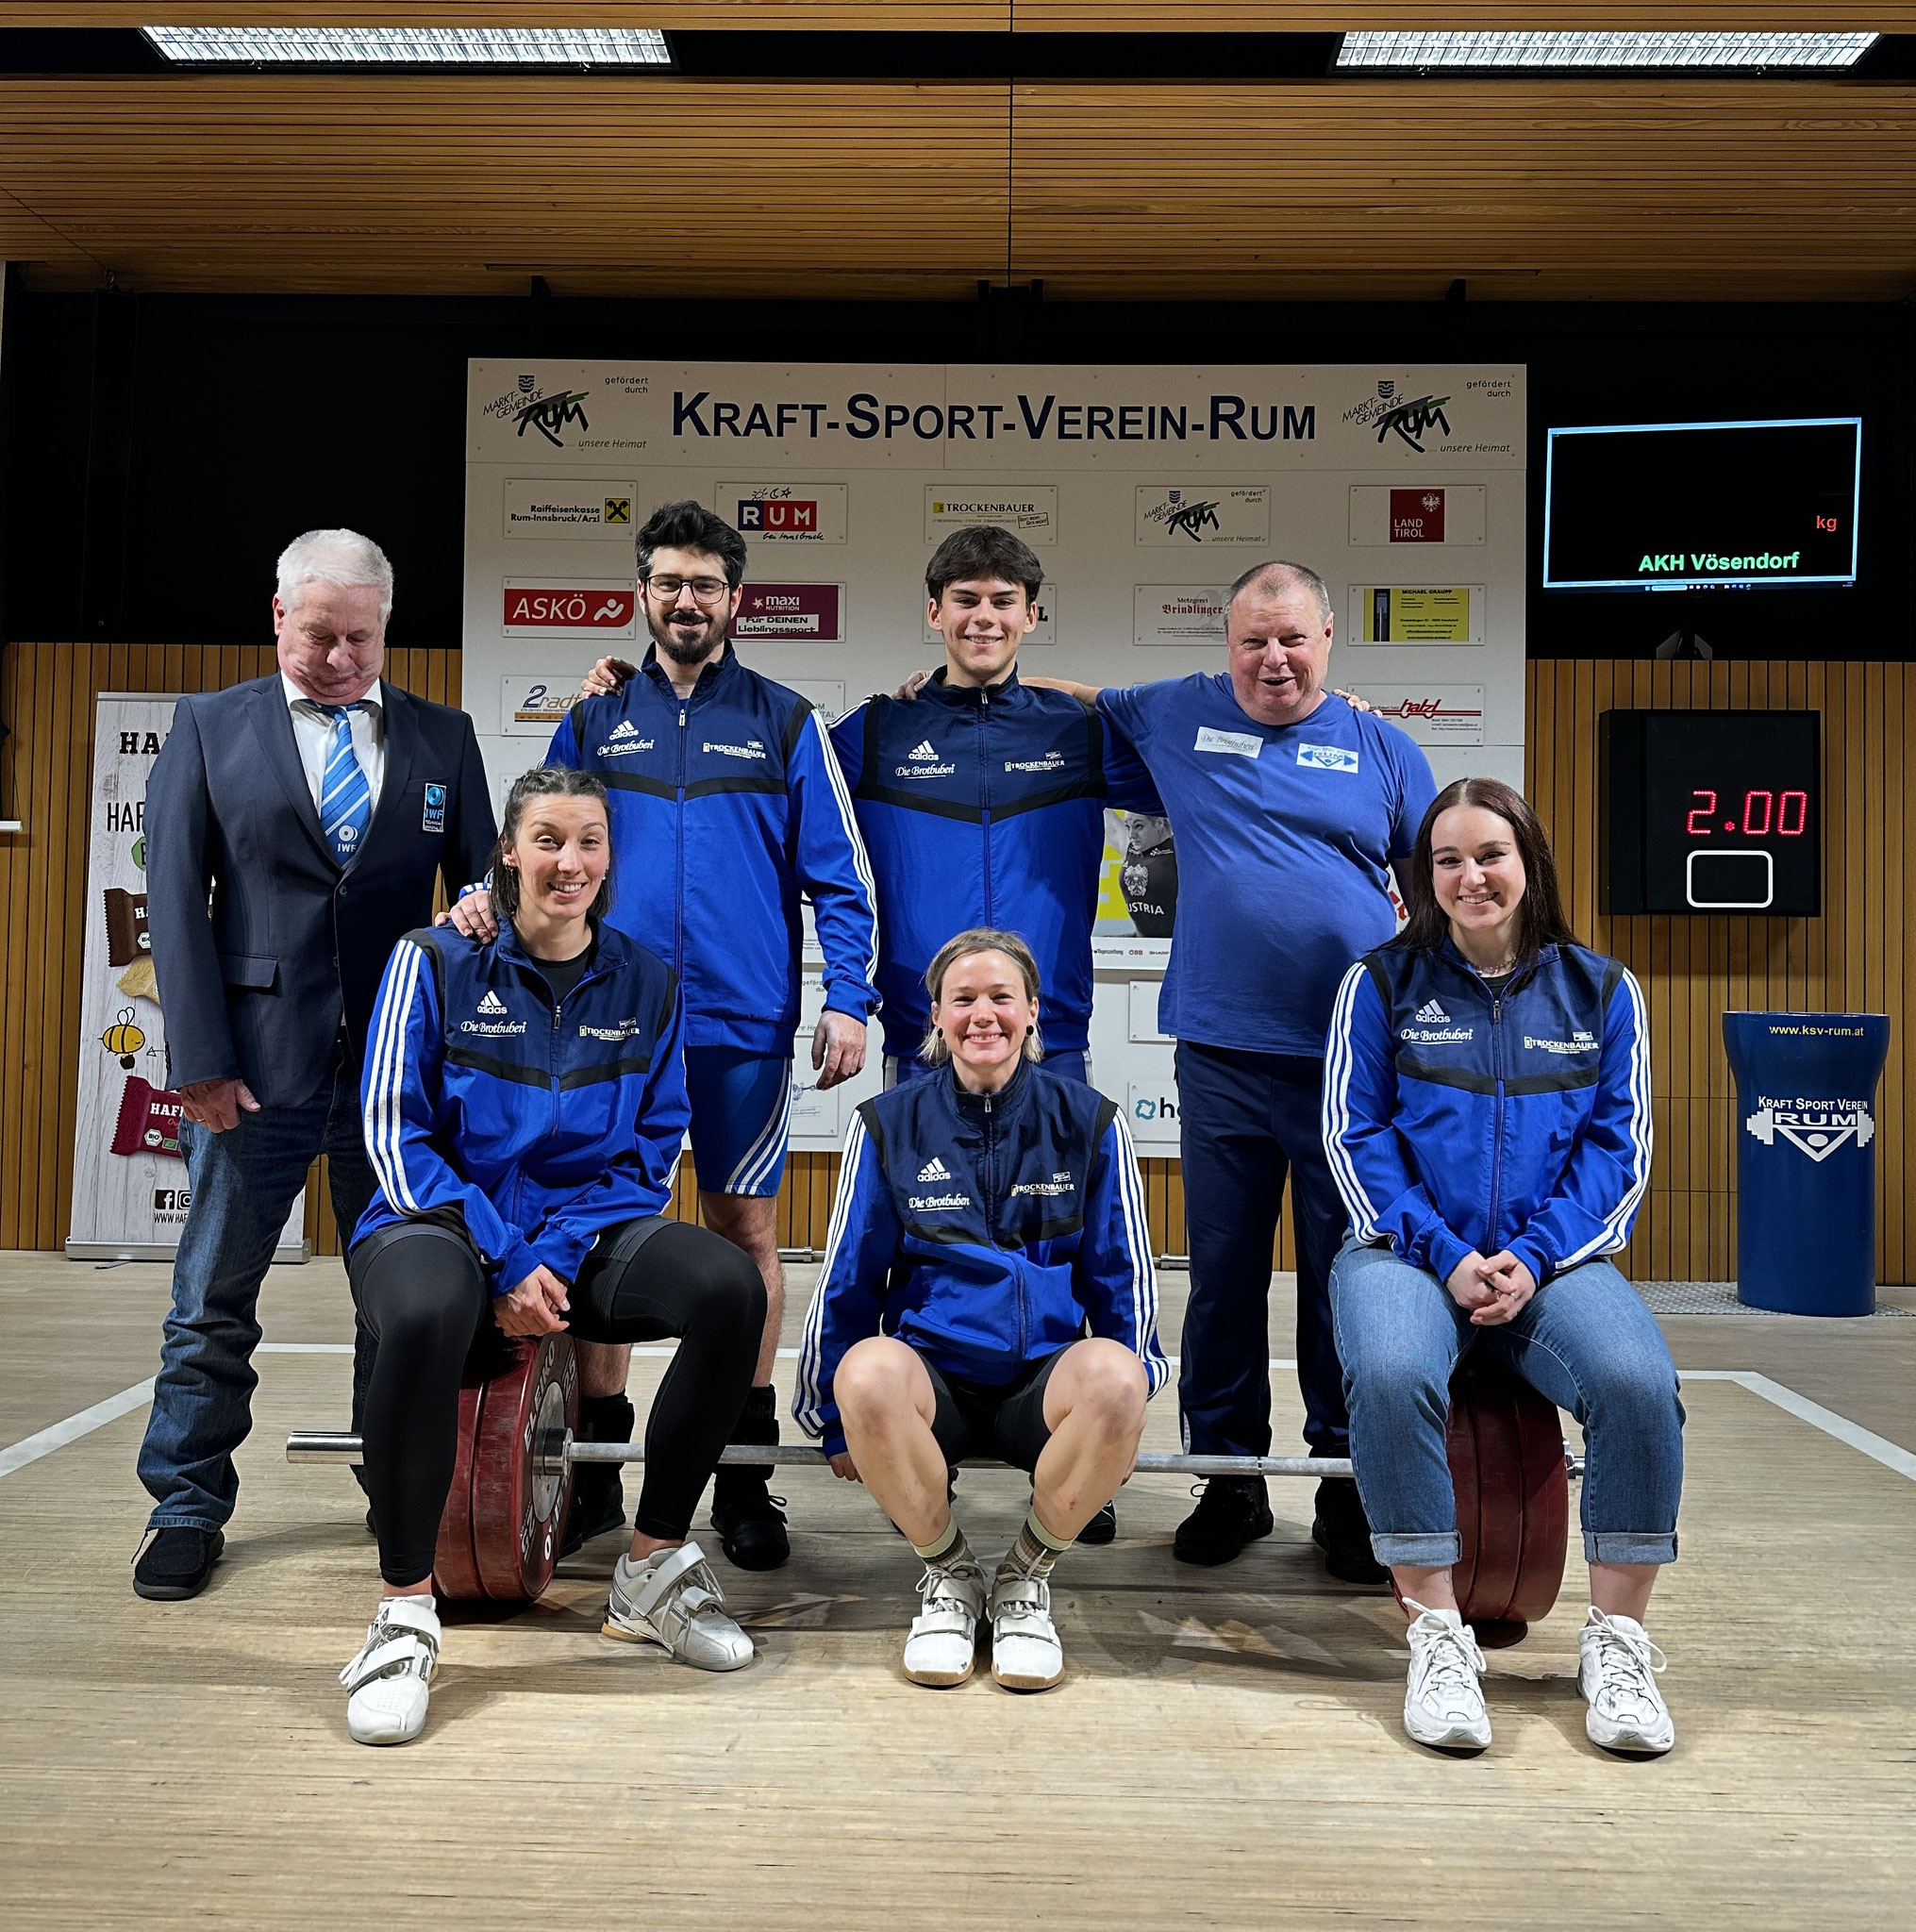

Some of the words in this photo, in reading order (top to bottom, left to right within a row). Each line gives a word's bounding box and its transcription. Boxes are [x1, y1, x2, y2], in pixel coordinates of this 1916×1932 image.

[605, 376, 648, 385] gefördert
[1466, 379, 1511, 389] gefördert
[483, 391, 519, 416] MARKT-
[496, 388, 543, 419] GEMEINDE
[1341, 396, 1378, 423] MARKT-
[1356, 393, 1404, 425] GEMEINDE
[518, 401, 590, 448] RUM
[1377, 405, 1451, 454] RUM
[578, 440, 610, 448] unsere
[612, 440, 647, 448] Heimat
[1441, 444, 1473, 453] unsere
[1474, 443, 1510, 453] Heimat
[530, 505, 600, 514] Raiffeisenkasse
[946, 503, 1035, 512] TROCKENBAUER
[1153, 500, 1187, 523] GEMEINDE
[510, 513, 600, 524] Rum-Innsbruck/Arzl
[742, 507, 810, 525] RUM
[1169, 508, 1220, 542] RUM
[1394, 519, 1423, 528] LAND
[1816, 515, 1837, 532] kg
[1394, 528, 1425, 538] TIROL
[1639, 555, 1684, 572] AKH
[1691, 551, 1800, 572] Vösendorf
[765, 595, 800, 606] maxi
[512, 593, 587, 621] ASKÖ
[1161, 604, 1224, 617] Brindlinger
[738, 625, 815, 635] Lieblingssport
[609, 729, 640, 741] adidas
[597, 744, 610, 757] Die
[710, 744, 766, 759] TROCKENBAUER
[908, 752, 940, 761] adidas
[1011, 759, 1065, 770] TROCKENBAUER
[895, 766, 910, 776] Die
[425, 808, 444, 820] IWF
[1687, 791, 1808, 836] 2.00
[337, 843, 357, 853] IWF
[476, 1006, 508, 1015] adidas
[1415, 1013, 1451, 1024] adidas
[460, 1020, 479, 1033] Die
[587, 1026, 641, 1037] TROCKENBAUER
[1769, 1024, 1864, 1037] www.ksv-rum.at
[1400, 1028, 1420, 1041] Die
[1532, 1039, 1599, 1050] TROCKENBAUER
[1758, 1095, 1793, 1109] KRAFT
[1795, 1097, 1836, 1111] SPORT
[1837, 1098, 1869, 1111] VEREIN
[1774, 1111, 1858, 1126] RUM
[917, 1172, 952, 1183] adidas
[1016, 1183, 1075, 1192] TROCKENBAUER
[908, 1196, 925, 1208] Die
